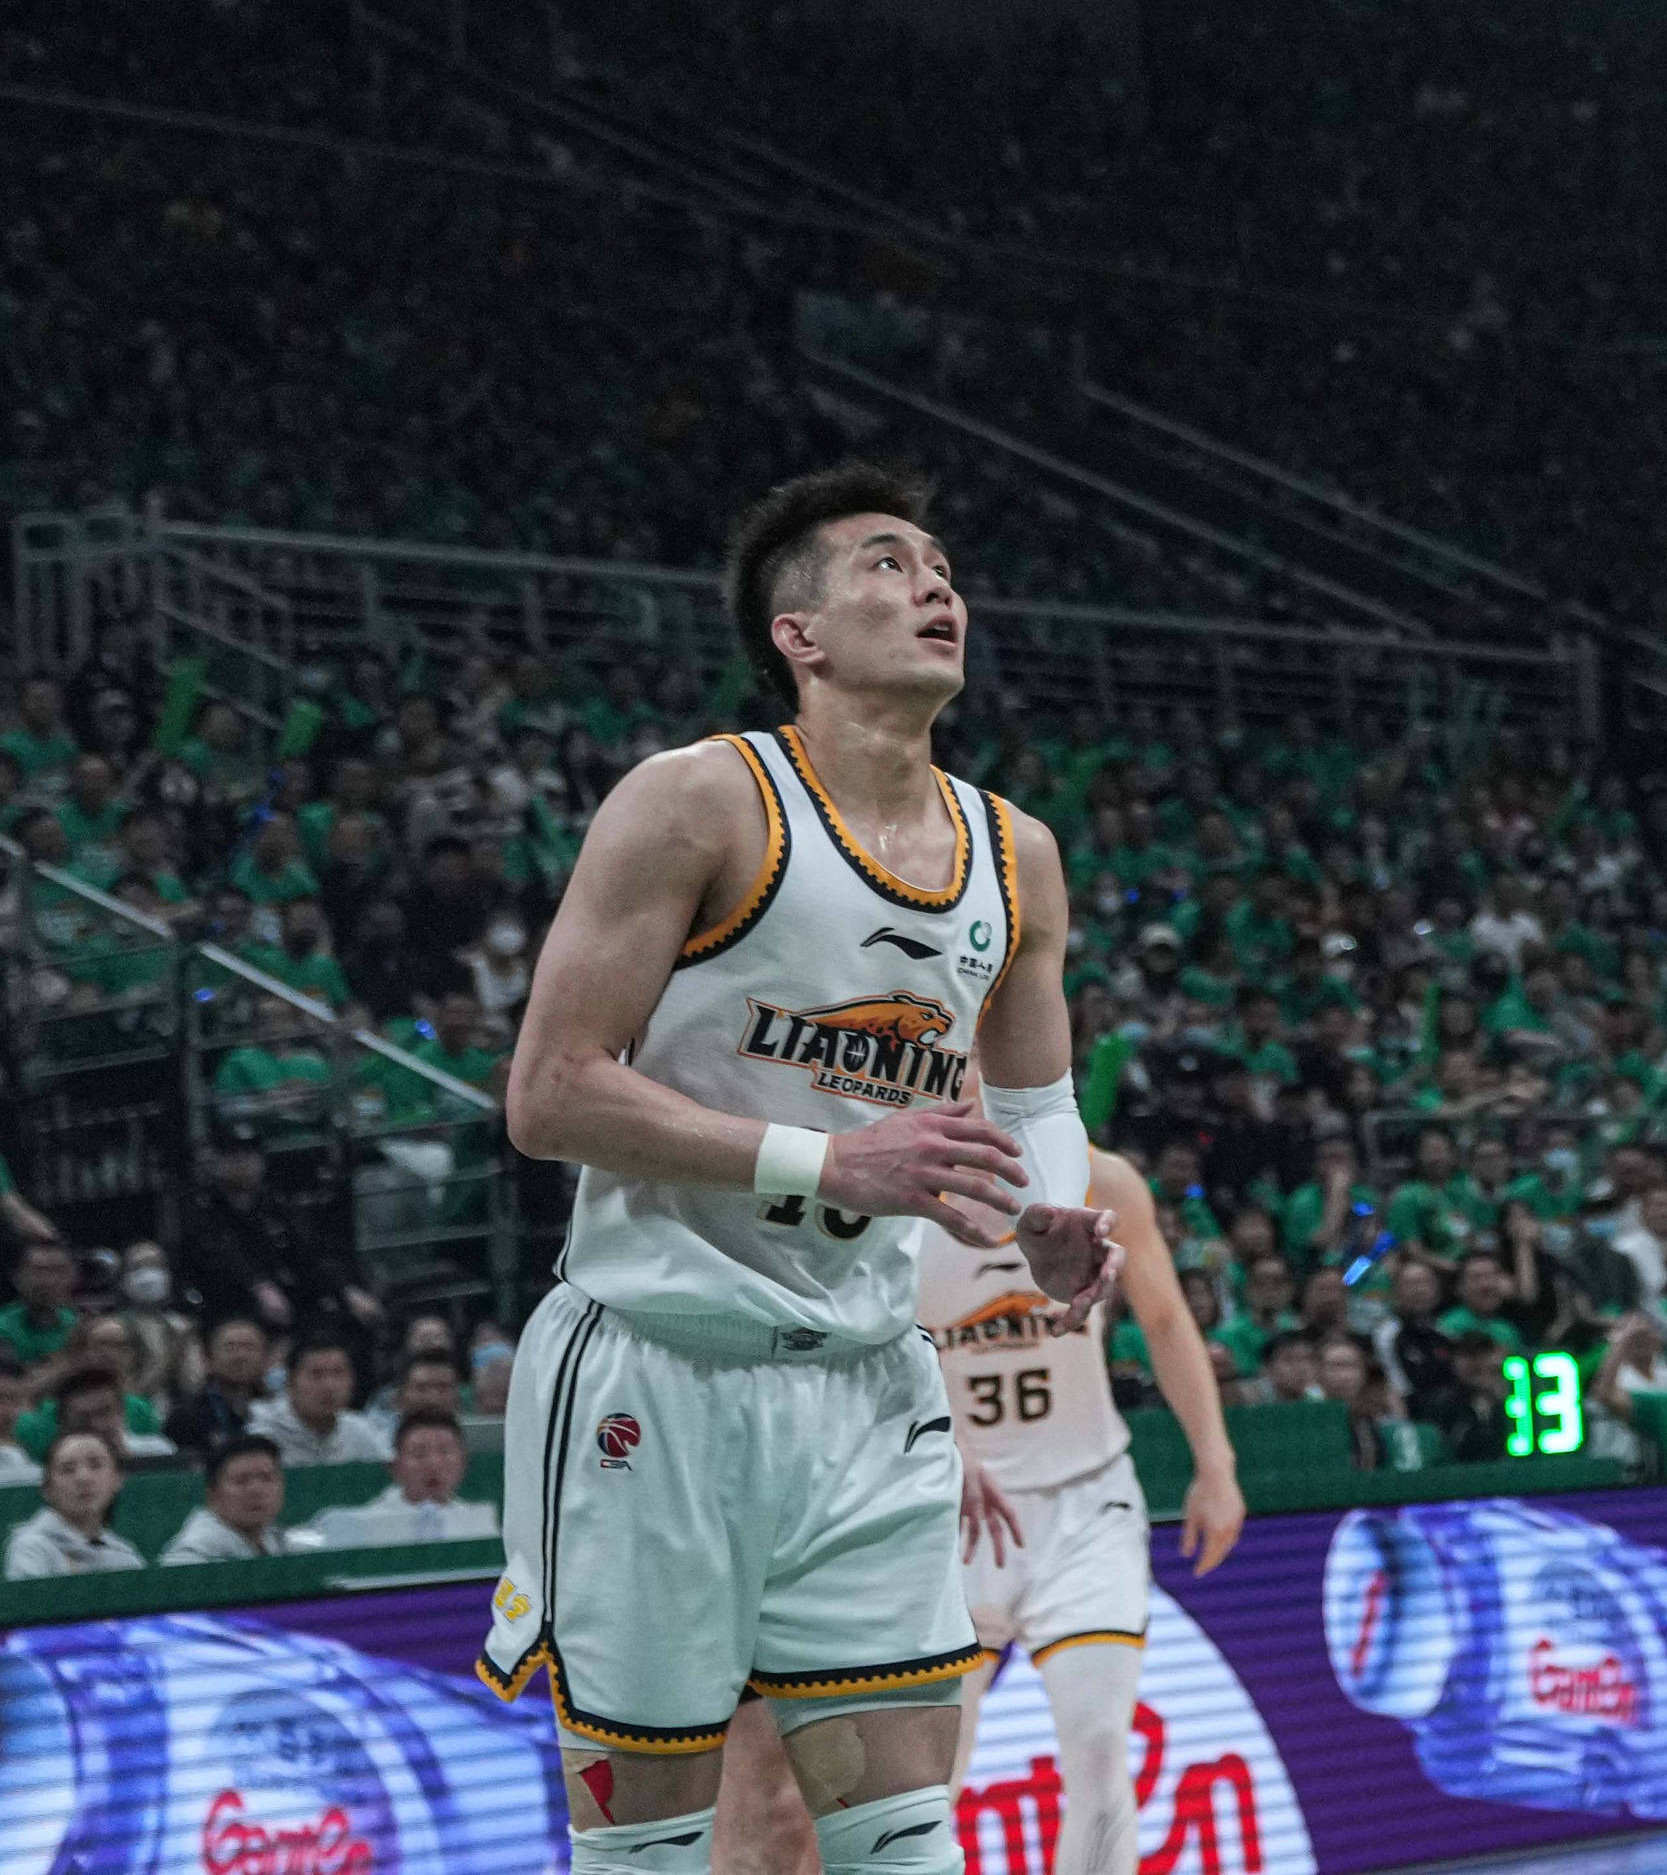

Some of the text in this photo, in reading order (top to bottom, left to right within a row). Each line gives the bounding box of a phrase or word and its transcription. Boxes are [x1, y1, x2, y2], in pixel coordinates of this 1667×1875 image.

[745, 1003, 968, 1103] LIAONING
[817, 1071, 912, 1105] LEOPARDS
[967, 1367, 1053, 1426] 36
